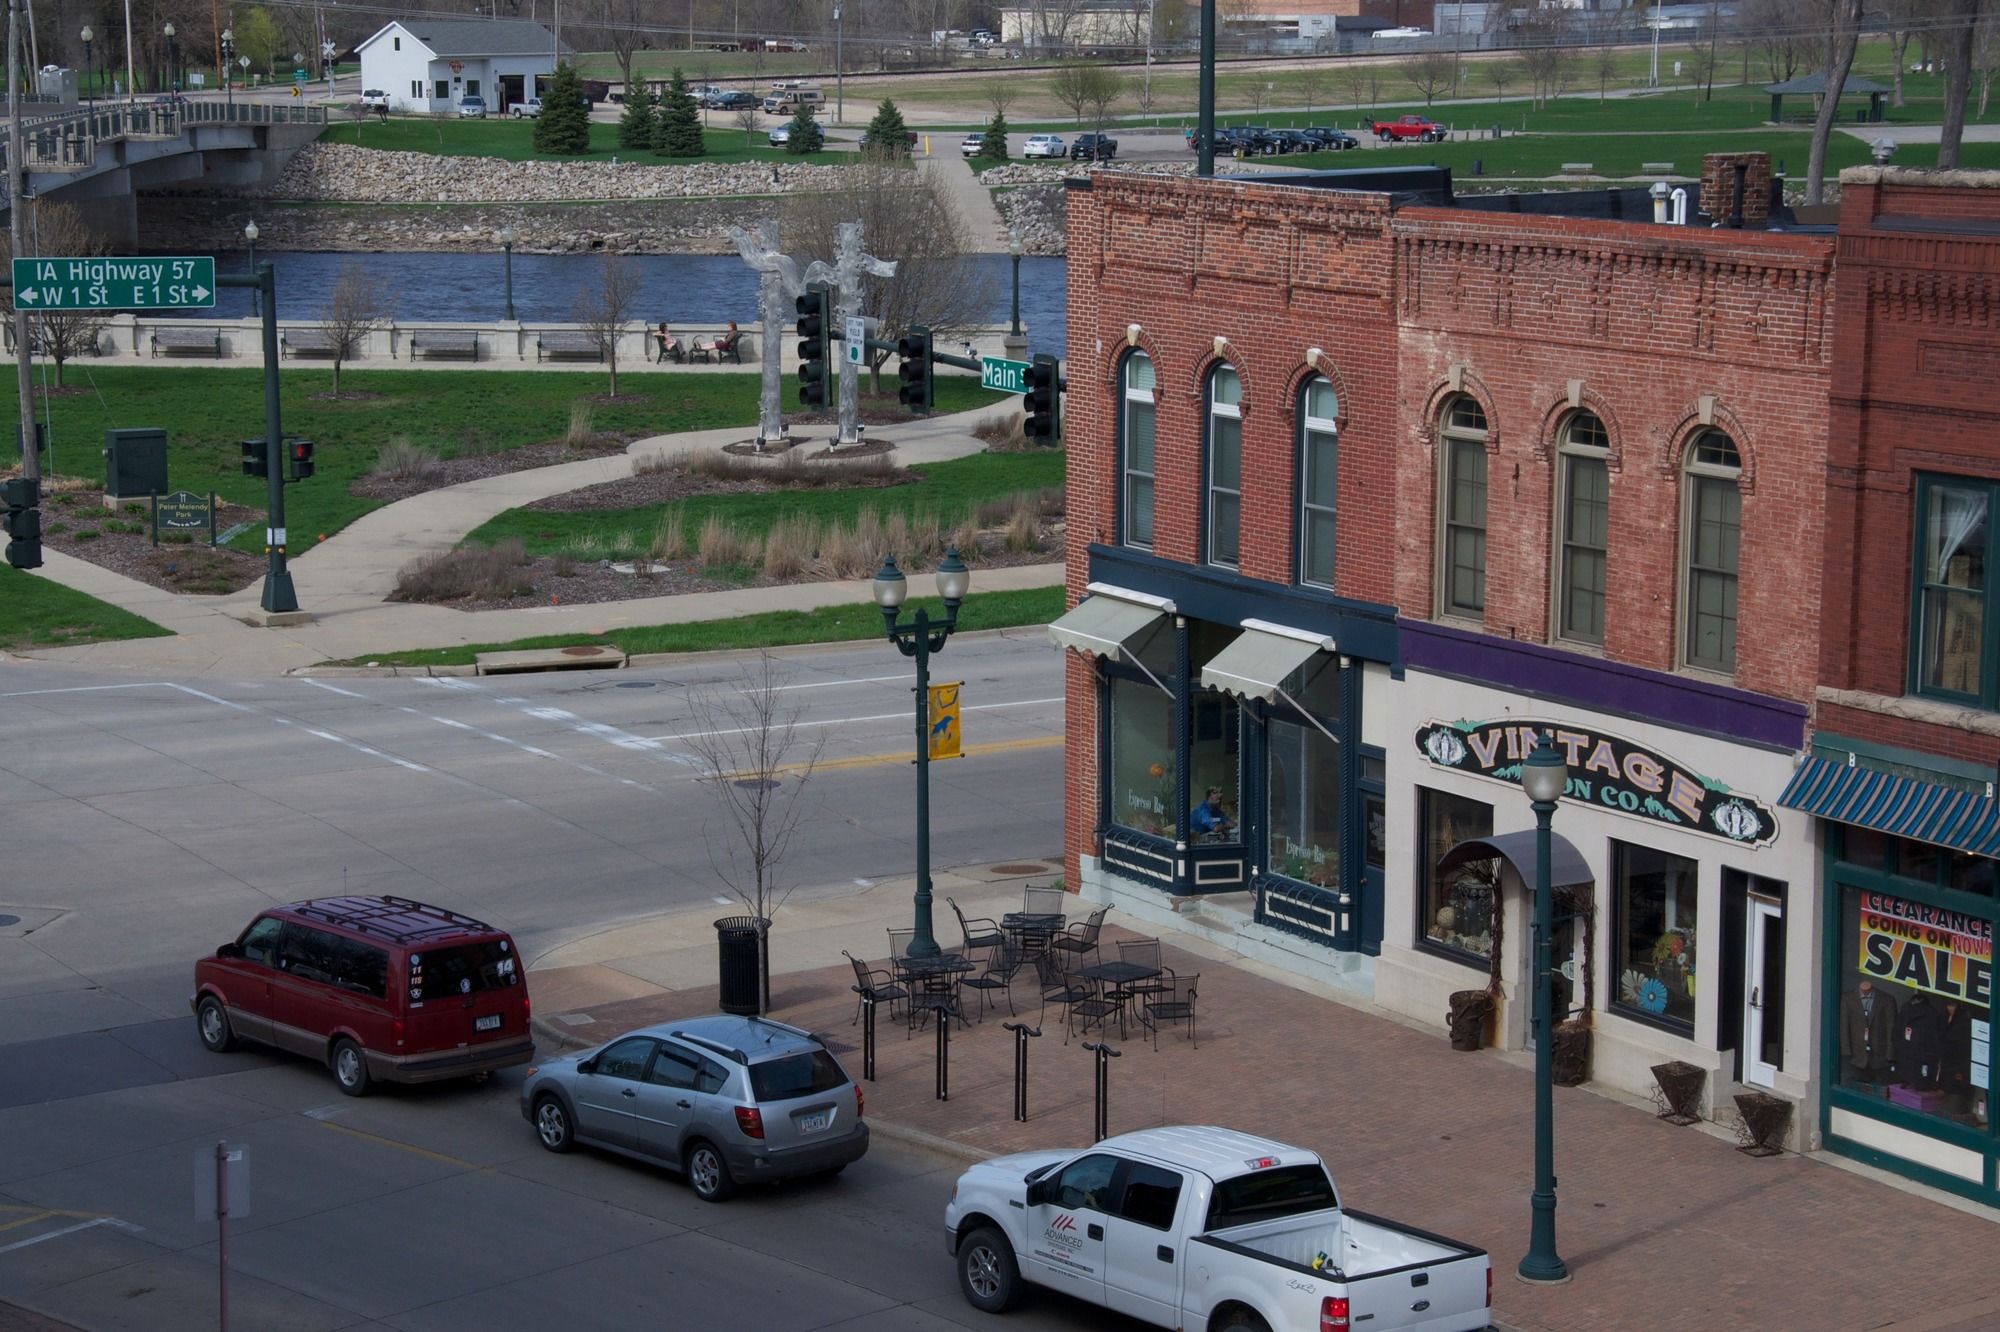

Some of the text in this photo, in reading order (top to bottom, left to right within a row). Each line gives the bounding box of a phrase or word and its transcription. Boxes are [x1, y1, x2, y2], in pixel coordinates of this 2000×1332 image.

[36, 260, 196, 286] IA Highway 57
[42, 284, 188, 305] W 1 St E 1 St
[983, 361, 1016, 389] Main
[159, 503, 178, 511] Peter
[175, 511, 192, 519] Park
[1467, 726, 1706, 824] VINTAGE
[1600, 785, 1646, 813] CO.
[1868, 891, 1992, 939] CLEARANCE
[1867, 914, 1991, 956] GOING ON NOW!
[1864, 933, 1992, 1004] SALE
[1044, 1228, 1083, 1248] ADVANCED
